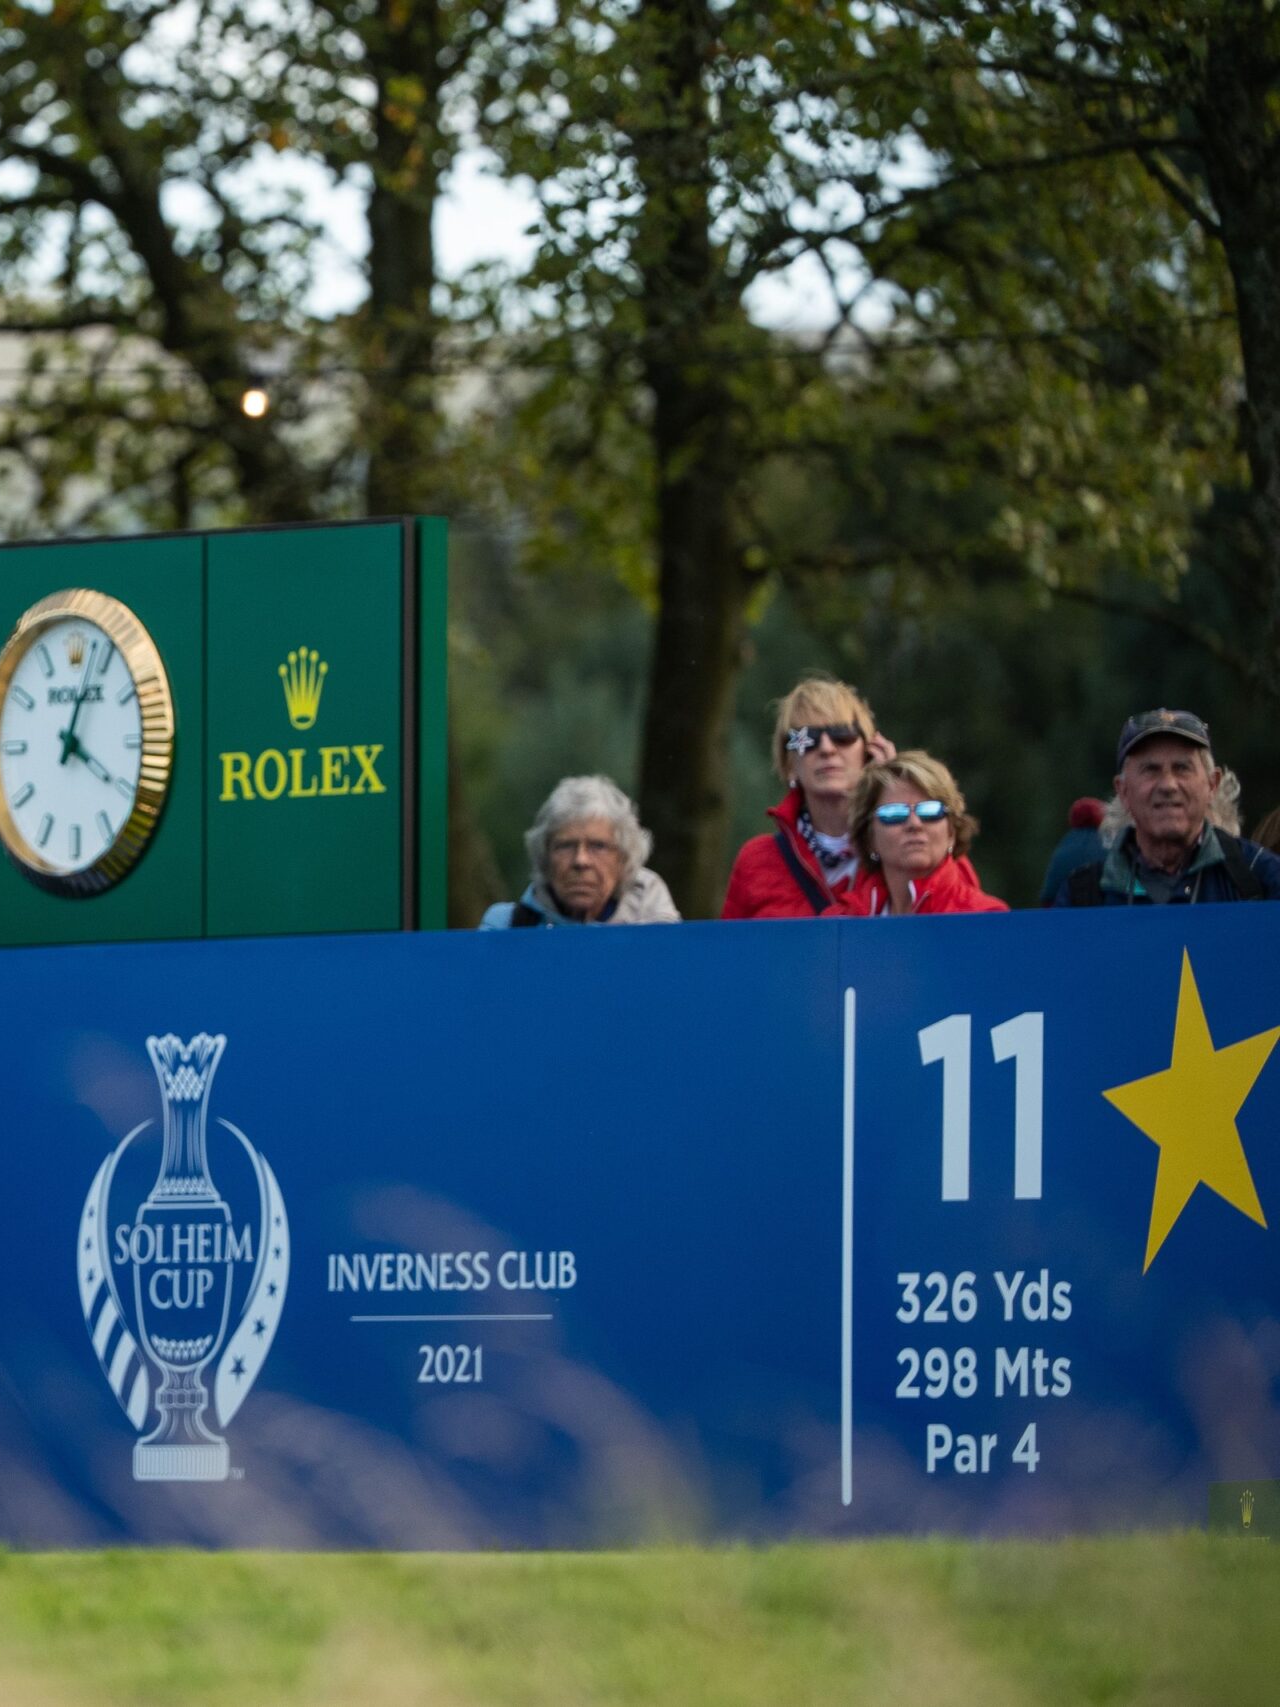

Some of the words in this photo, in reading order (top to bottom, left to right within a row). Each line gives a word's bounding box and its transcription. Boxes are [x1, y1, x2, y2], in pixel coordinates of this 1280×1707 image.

[219, 744, 387, 802] ROLEX
[917, 1011, 1044, 1202] 11
[114, 1223, 255, 1265] SOLHEIM
[148, 1268, 215, 1310] CUP
[327, 1251, 492, 1292] INVERNESS
[497, 1250, 578, 1290] CLUB
[895, 1270, 978, 1324] 326
[993, 1268, 1072, 1322] Yds
[417, 1344, 484, 1384] 2021
[895, 1346, 978, 1399] 298
[994, 1346, 1072, 1398] Mts
[926, 1423, 998, 1474] Par
[1011, 1421, 1041, 1474] 4
